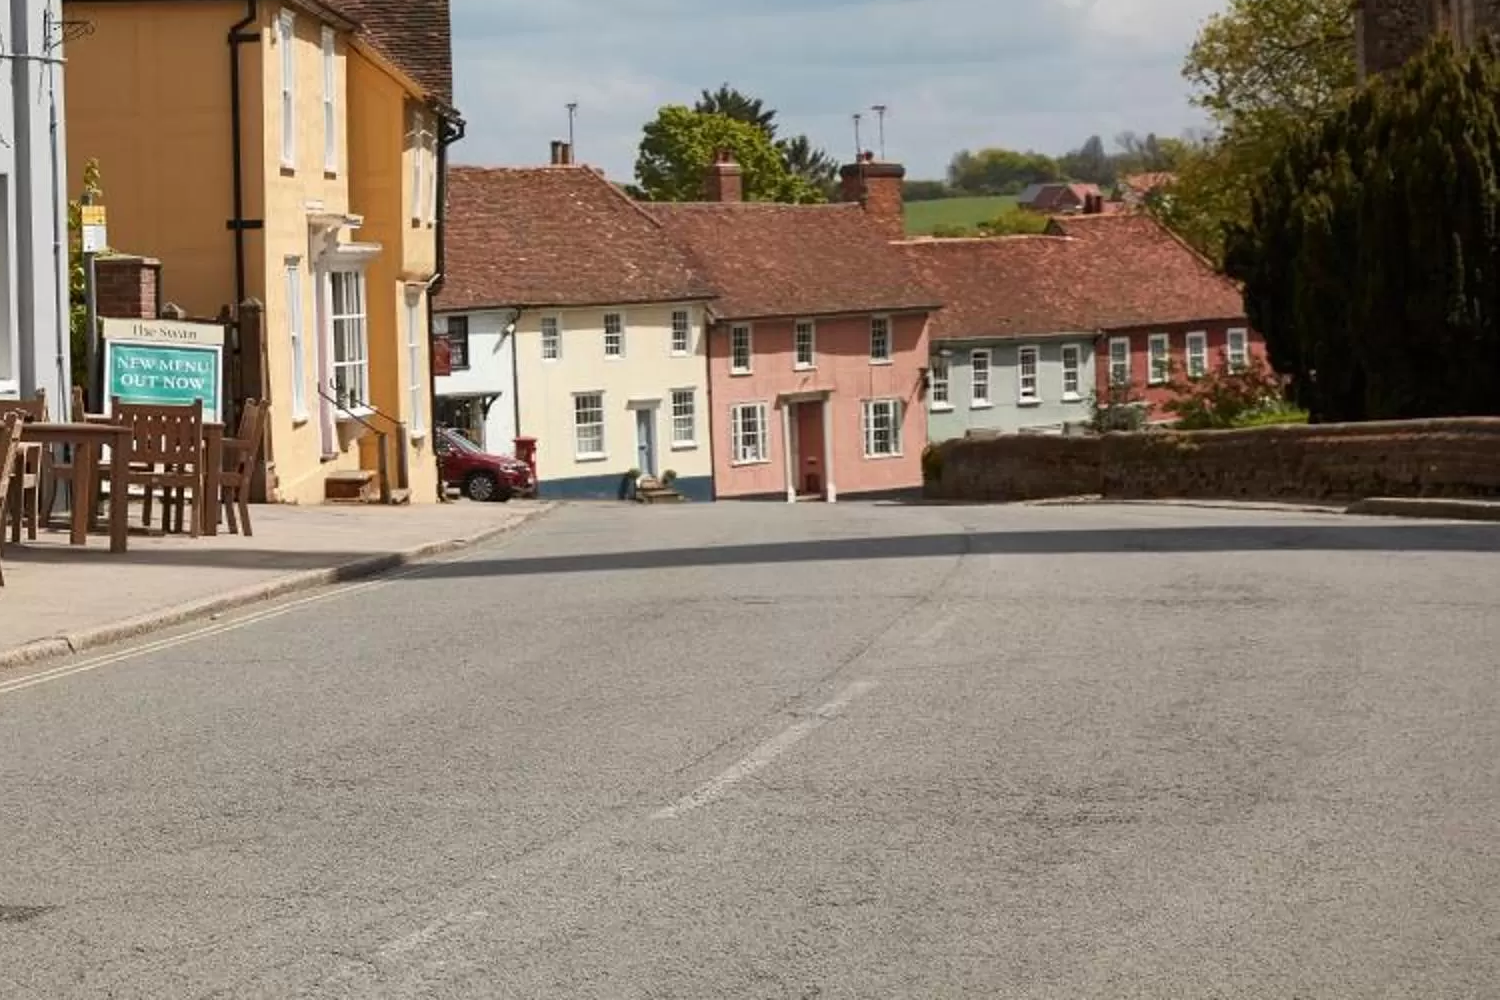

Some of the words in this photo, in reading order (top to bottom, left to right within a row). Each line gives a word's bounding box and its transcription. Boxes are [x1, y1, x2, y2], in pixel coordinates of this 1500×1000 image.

[133, 324, 156, 337] The
[160, 326, 197, 339] Swan
[117, 356, 156, 371] NEW
[159, 359, 209, 373] MENU
[120, 373, 159, 388] OUT
[163, 375, 204, 389] NOW
